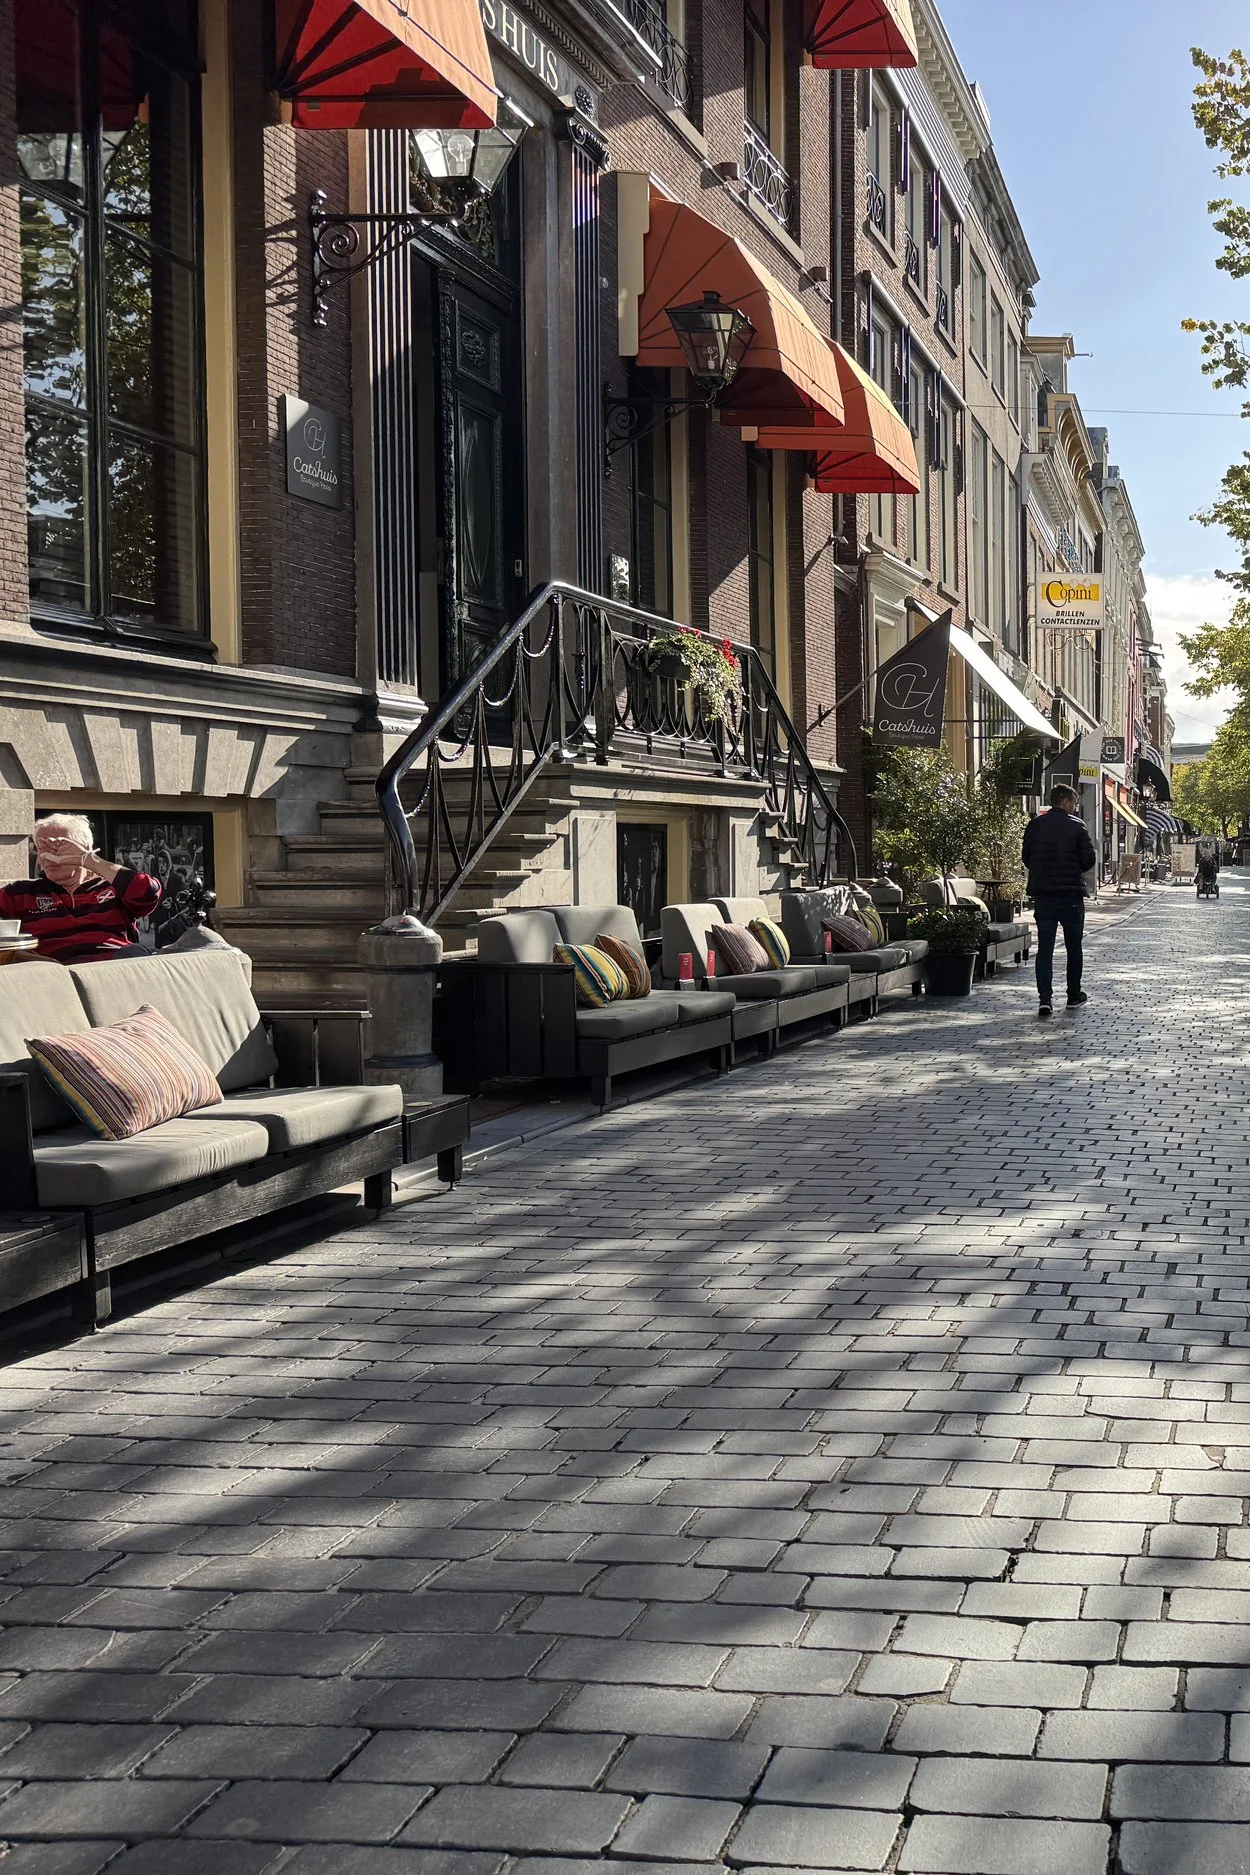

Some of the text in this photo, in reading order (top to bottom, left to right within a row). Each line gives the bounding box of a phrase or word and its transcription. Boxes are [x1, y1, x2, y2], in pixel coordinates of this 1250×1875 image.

[482, 0, 559, 91] SHUIS
[293, 456, 338, 485] Catshuis
[1045, 579, 1093, 608] Copini
[1040, 617, 1101, 626] CONTACTLENZEN
[878, 719, 936, 735] Catshuis
